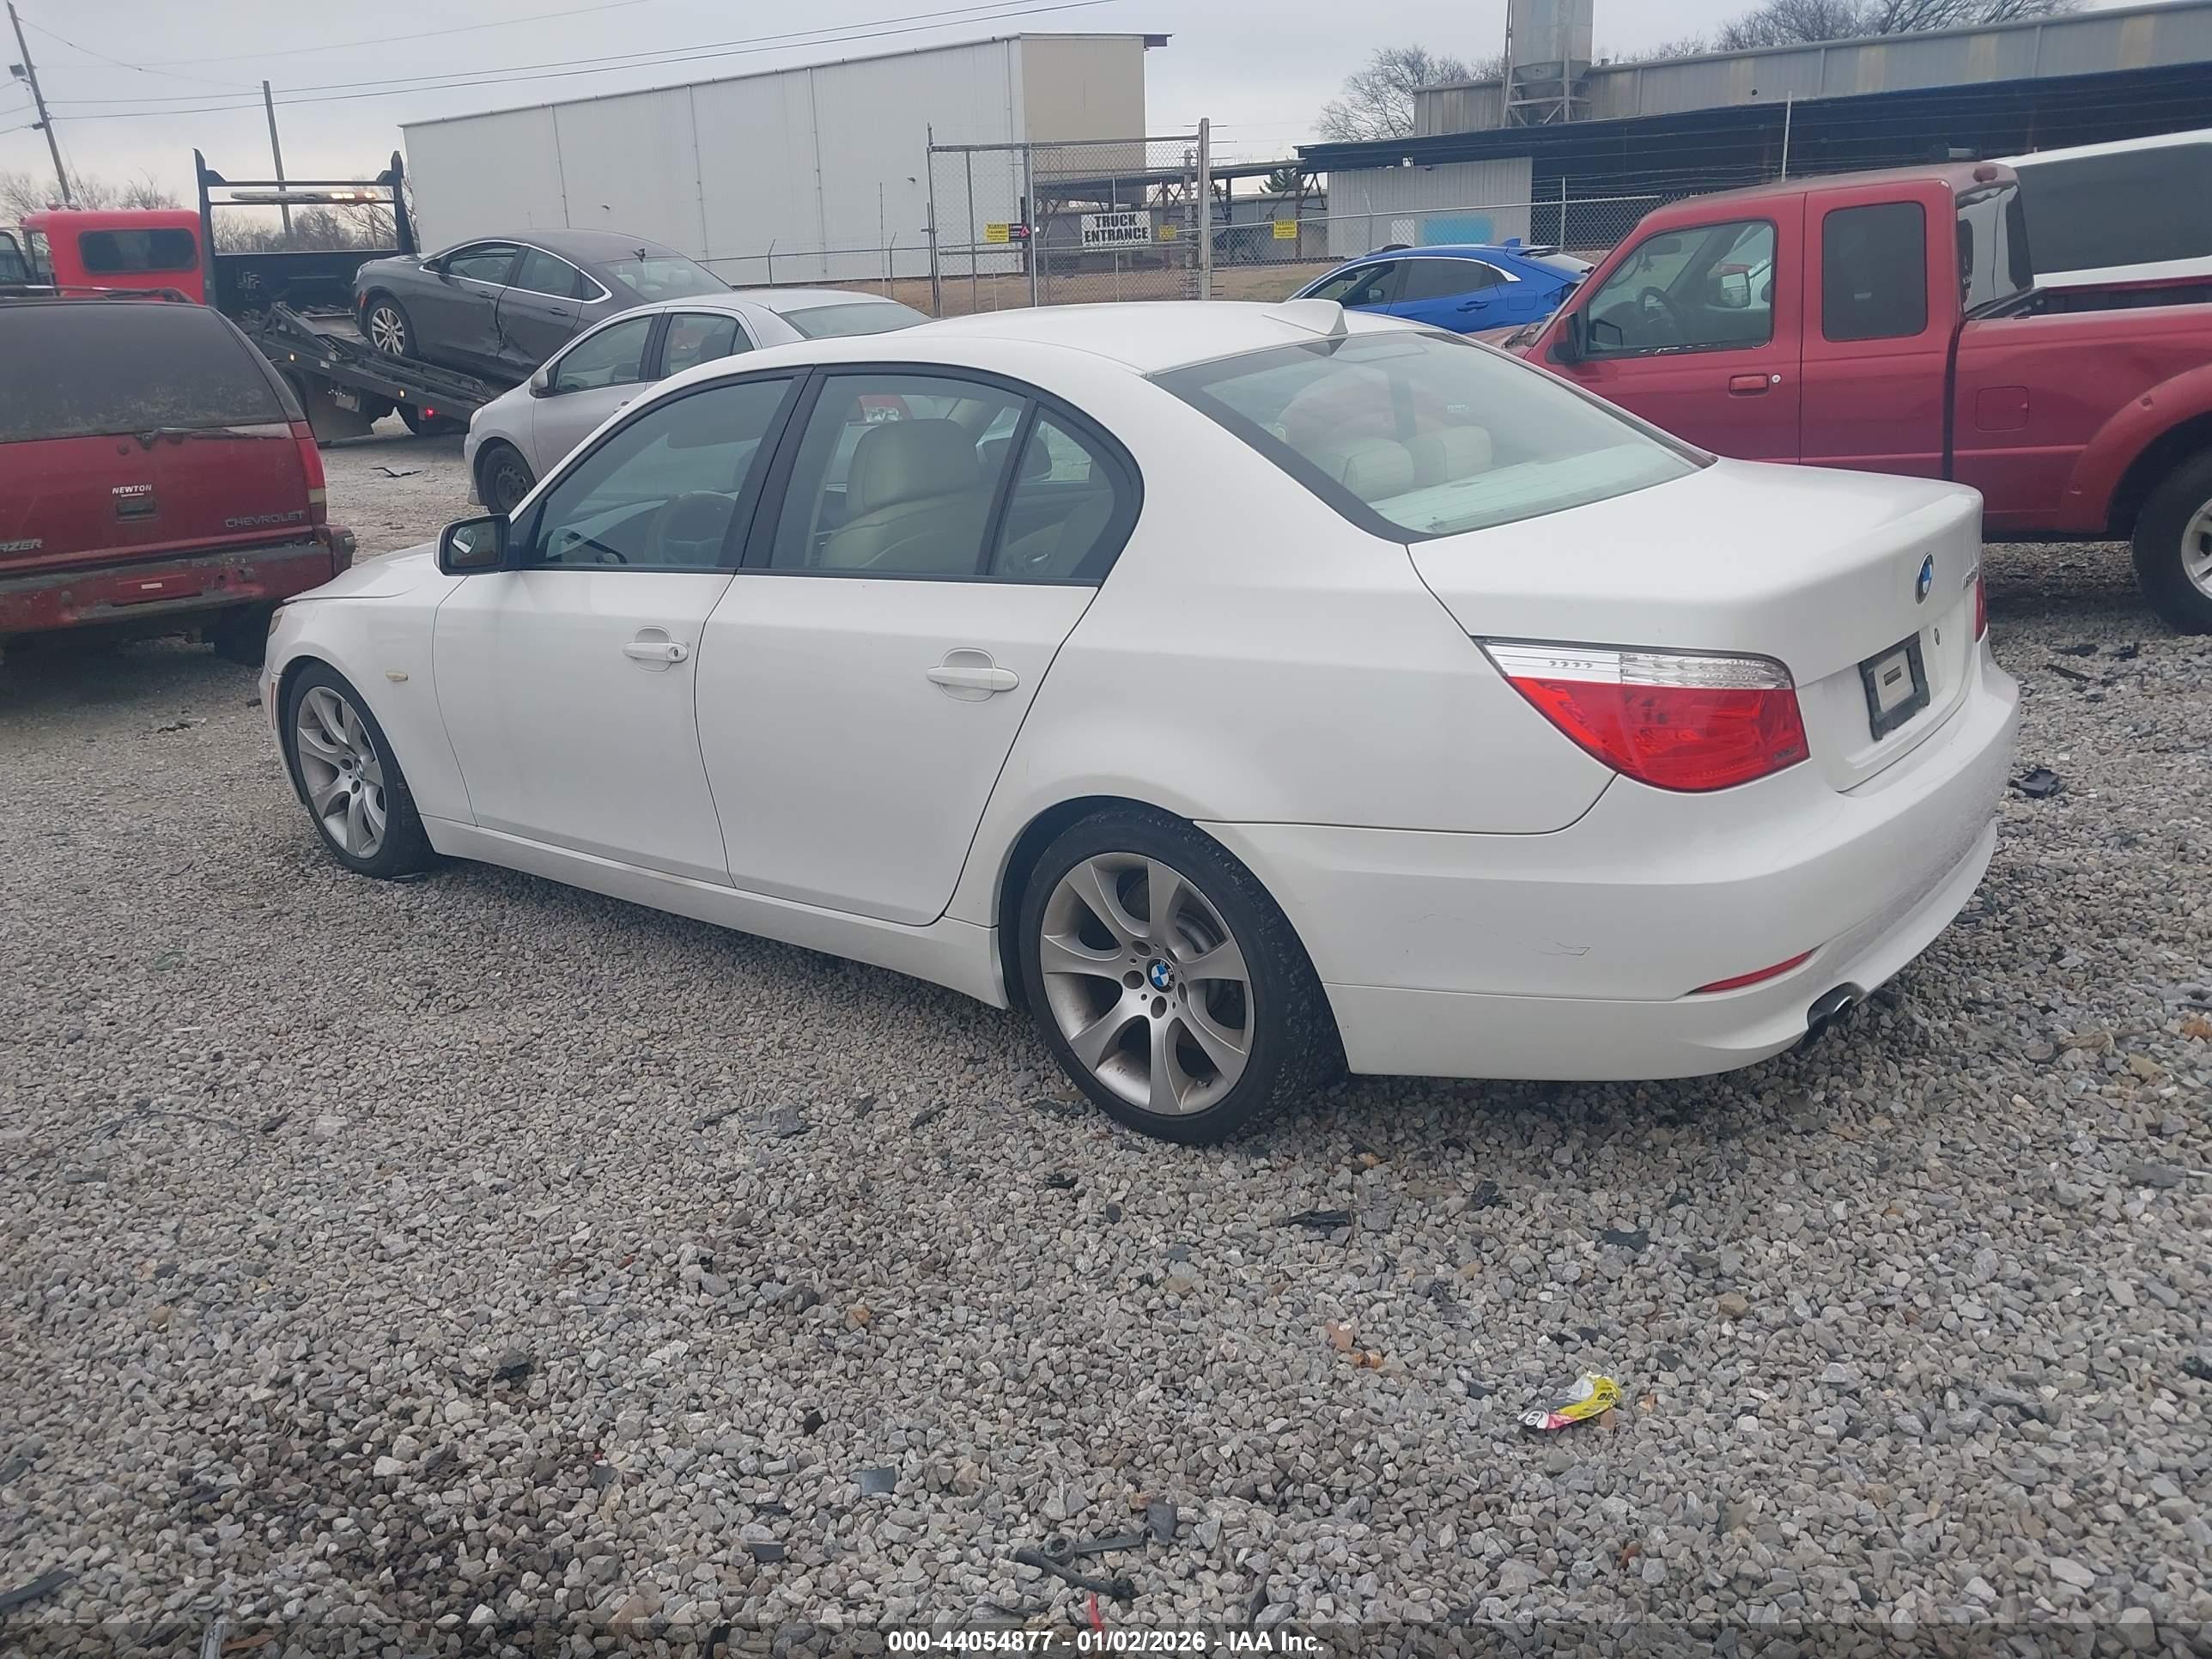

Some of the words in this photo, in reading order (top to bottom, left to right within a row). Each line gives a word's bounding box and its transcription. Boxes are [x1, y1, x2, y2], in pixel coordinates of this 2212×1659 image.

[1094, 214, 1138, 228] TRUCK
[1084, 227, 1149, 242] ENTRANCE
[112, 483, 152, 495] NEWTON
[225, 510, 303, 527] CHEVROLET
